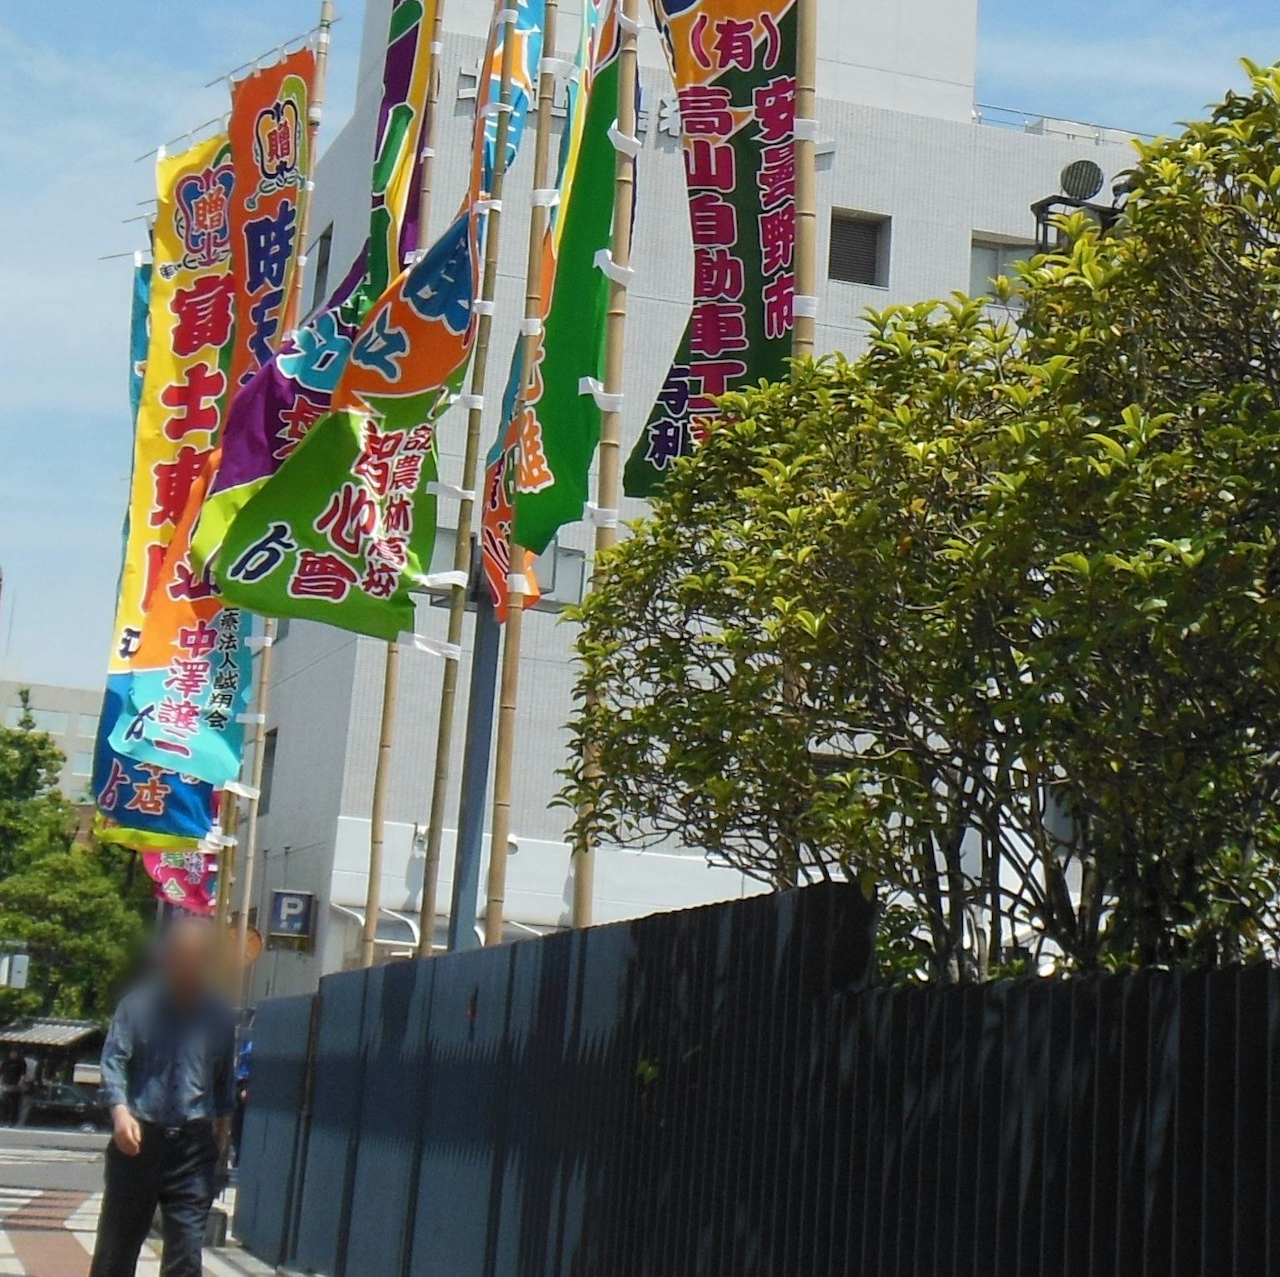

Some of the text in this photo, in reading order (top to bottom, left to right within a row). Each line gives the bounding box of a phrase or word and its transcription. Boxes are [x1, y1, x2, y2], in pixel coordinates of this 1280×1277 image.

[677, 83, 747, 444] 高山自動車工
[203, 607, 249, 730] 療法人誠翔会
[280, 896, 304, 920] P
